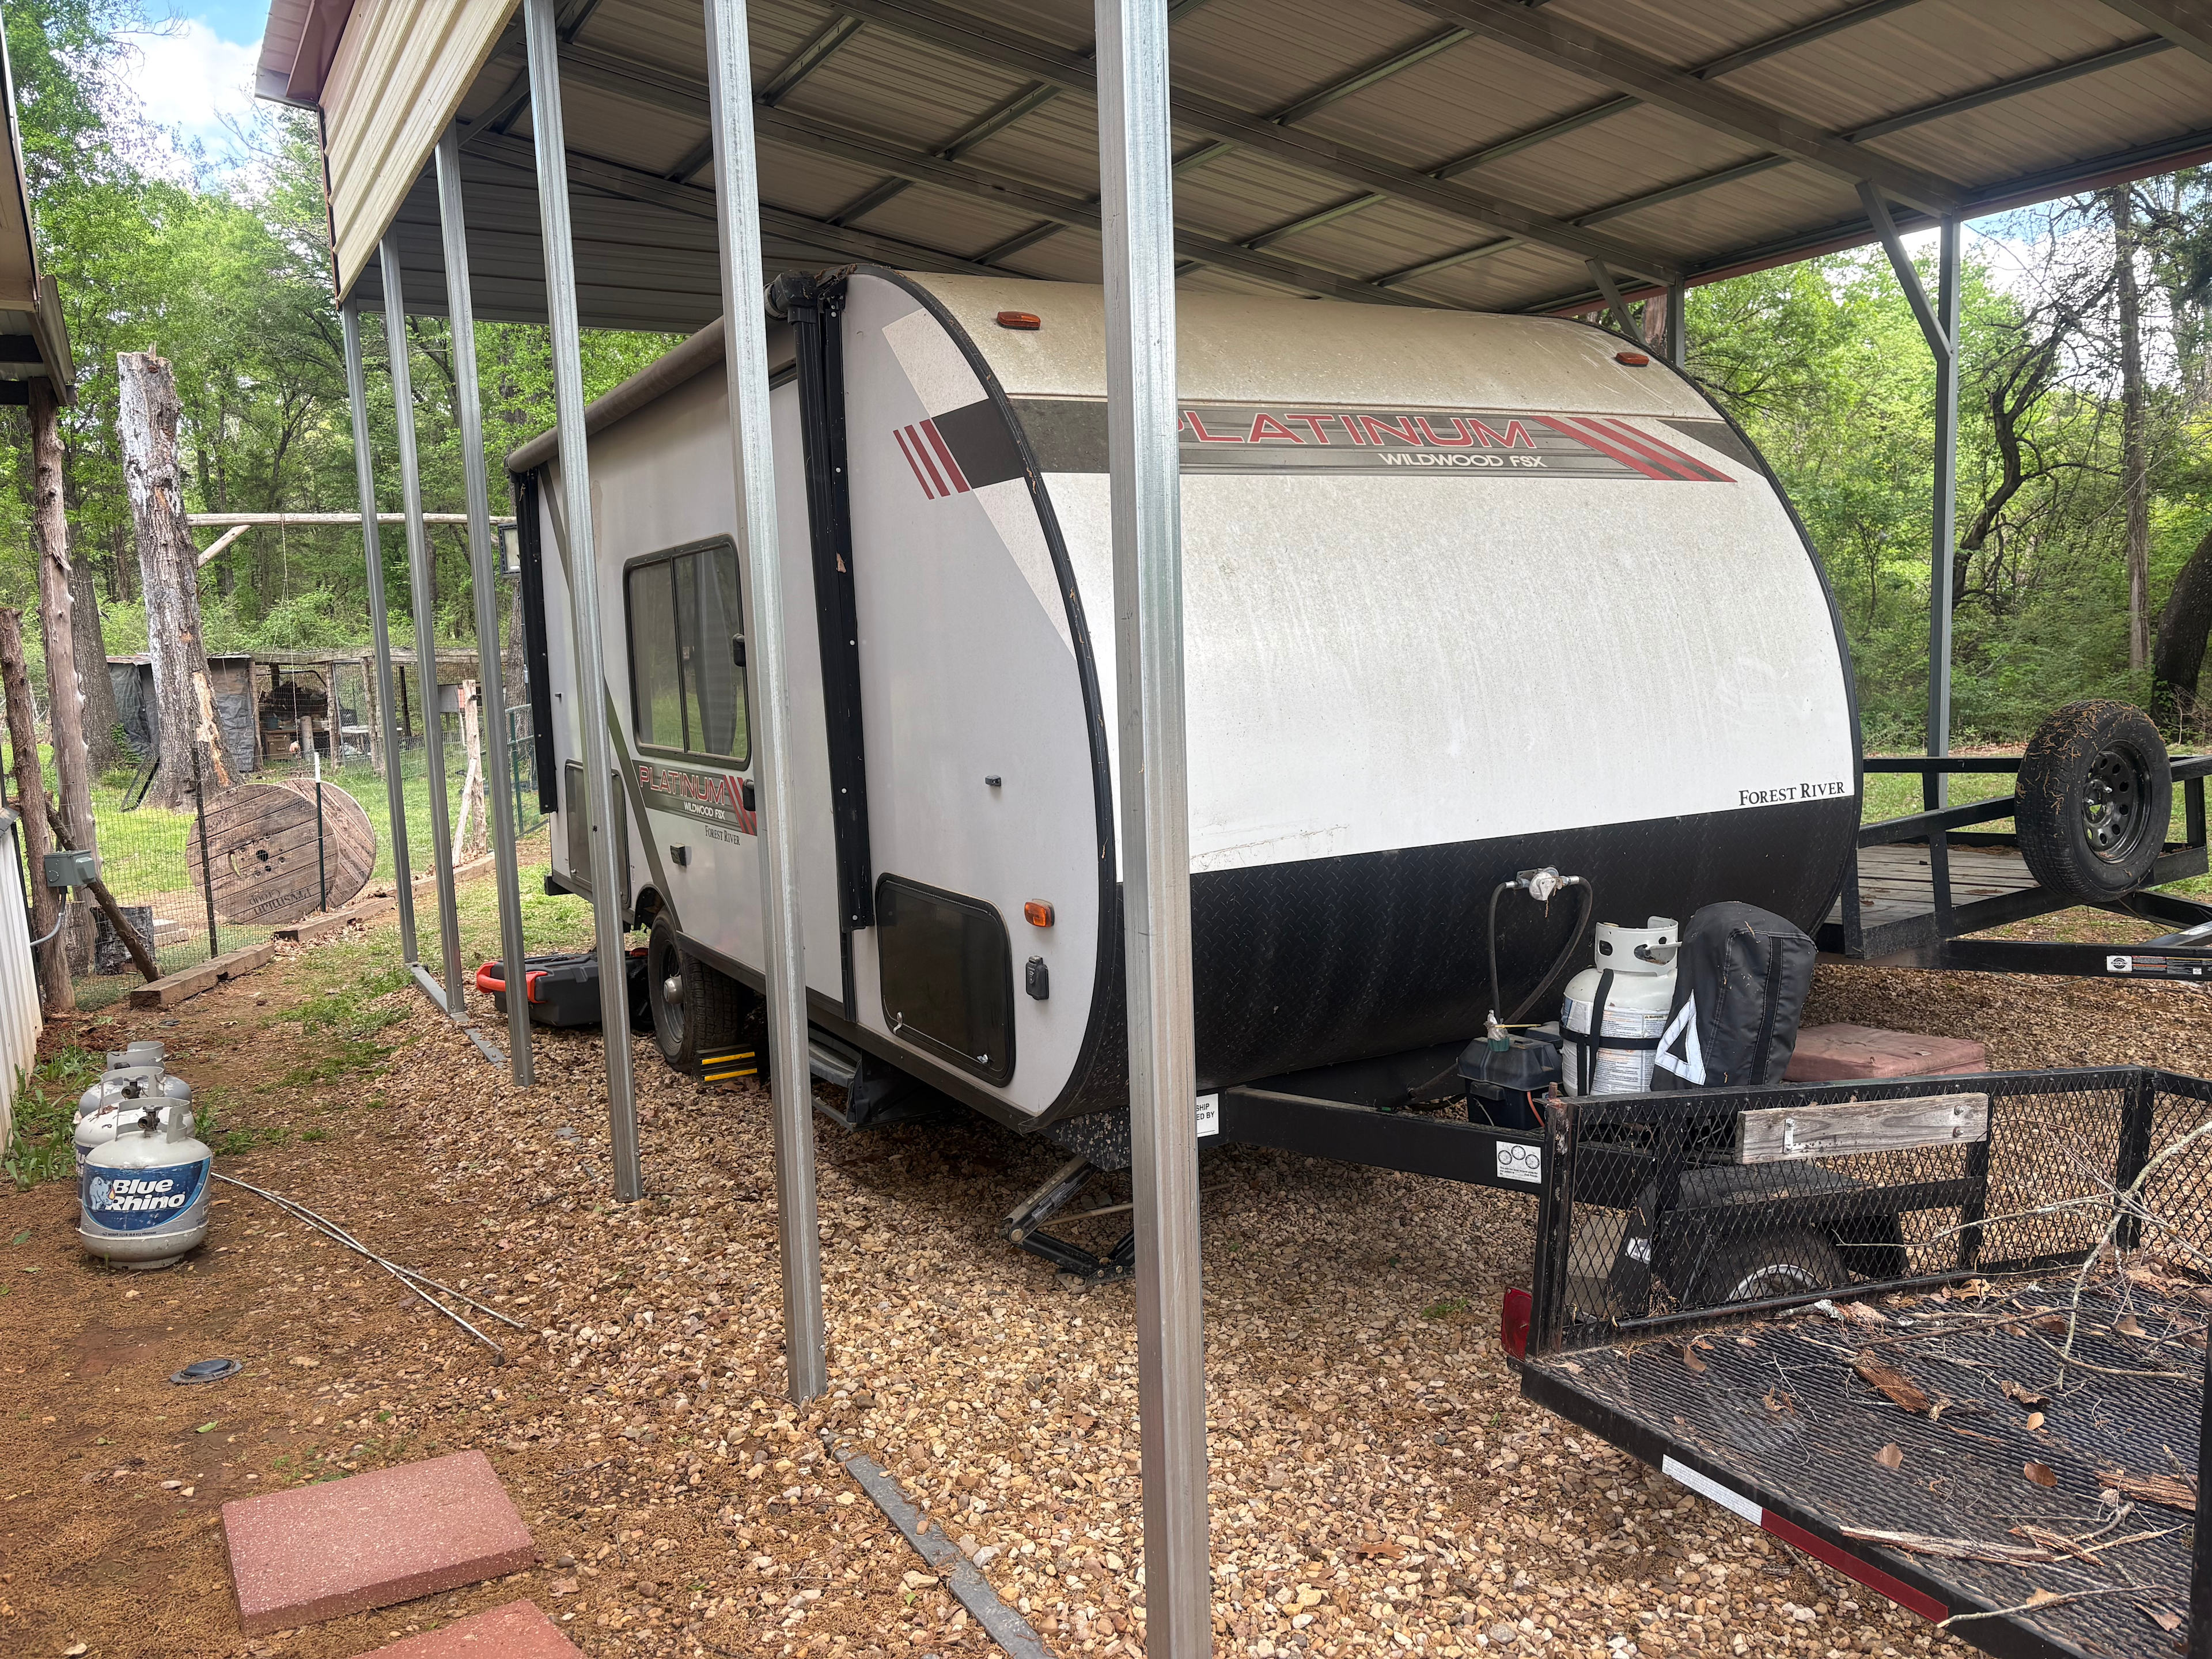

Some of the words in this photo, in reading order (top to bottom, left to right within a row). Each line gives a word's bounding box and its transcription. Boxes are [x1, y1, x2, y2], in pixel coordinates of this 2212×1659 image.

[1179, 410, 1536, 449] LATINUM
[1378, 453, 1504, 467] WILDWOOD
[1510, 455, 1547, 468] FSX
[639, 765, 725, 805] PLATINUM
[1738, 787, 1797, 806] FOREST
[1800, 781, 1846, 798] RIVER
[683, 801, 714, 817] WILDWOOD
[715, 809, 725, 820] FSX
[705, 825, 723, 841] FOREST
[724, 830, 740, 846] RIVER
[248, 889, 281, 906] Group
[253, 888, 312, 915] Prysmian
[112, 1179, 173, 1195] Blue
[105, 1193, 185, 1211] Rhino
